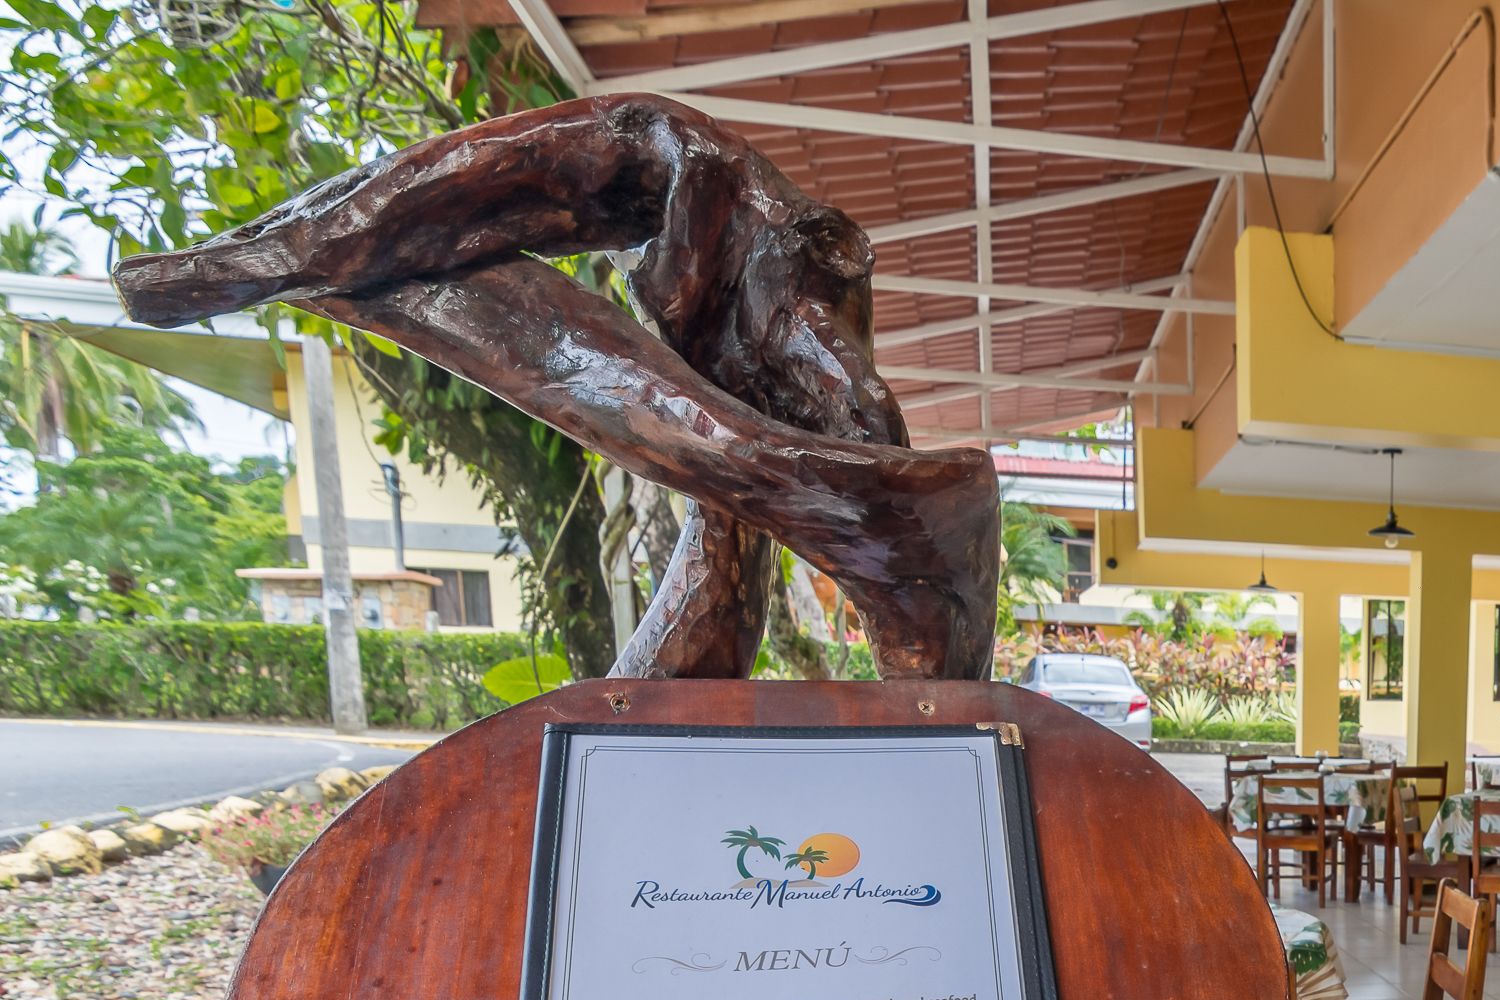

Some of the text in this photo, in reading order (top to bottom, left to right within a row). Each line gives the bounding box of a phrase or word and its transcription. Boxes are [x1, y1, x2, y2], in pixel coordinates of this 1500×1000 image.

[631, 877, 921, 910] Restaurante Manuel Antonio
[733, 941, 852, 972] MENÚ
